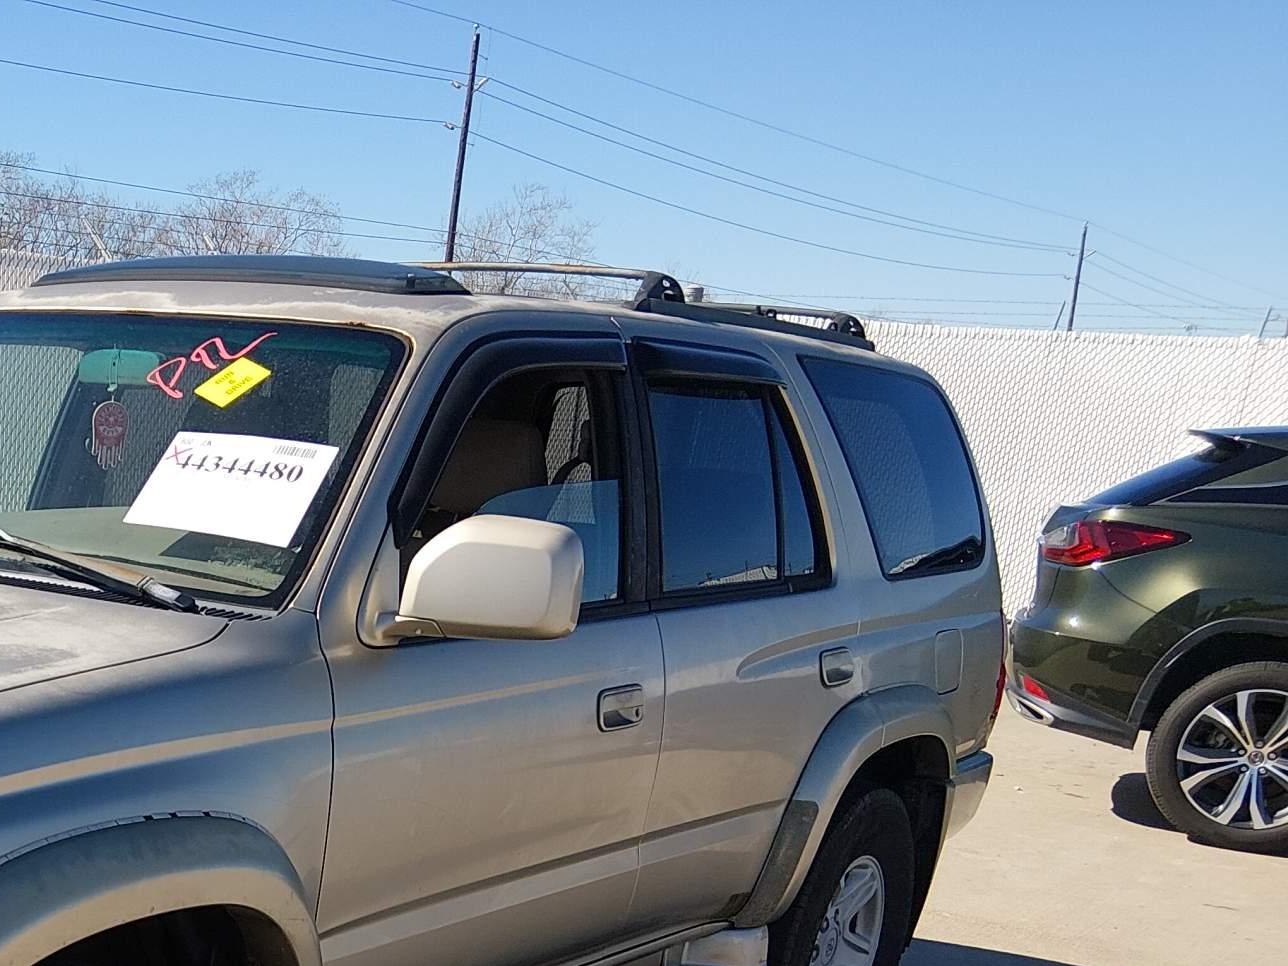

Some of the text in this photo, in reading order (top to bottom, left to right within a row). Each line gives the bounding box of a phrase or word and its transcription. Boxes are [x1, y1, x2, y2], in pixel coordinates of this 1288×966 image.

[214, 371, 235, 385] RUN
[225, 376, 254, 396] DRIVE
[176, 453, 305, 483] 44344480
